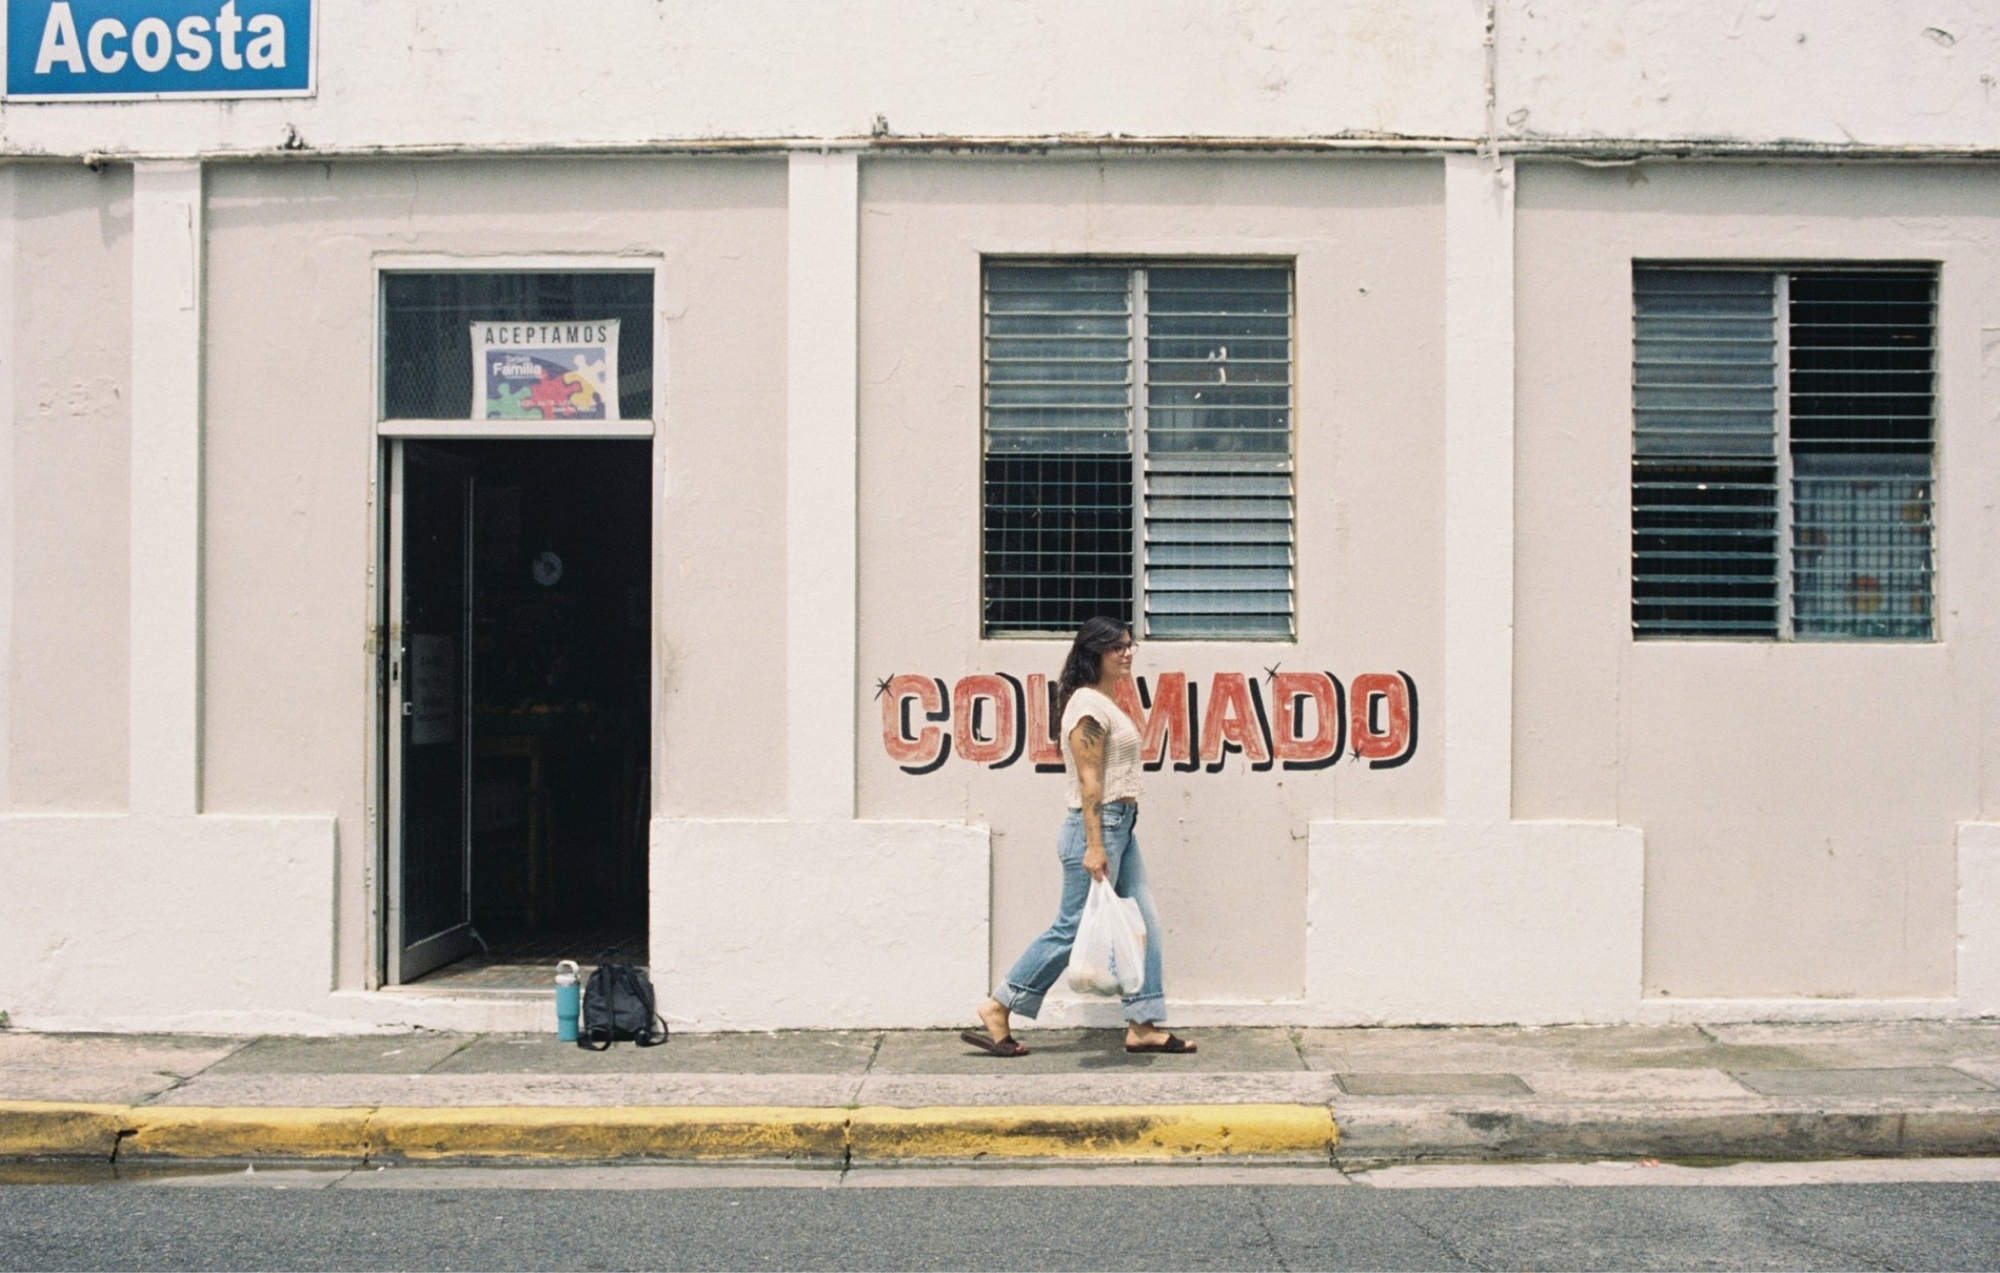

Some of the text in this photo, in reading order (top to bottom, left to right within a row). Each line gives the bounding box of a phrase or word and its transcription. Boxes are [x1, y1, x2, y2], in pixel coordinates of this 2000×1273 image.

[34, 0, 286, 74] Acosta
[485, 325, 607, 344] ACEPTAMOS
[493, 362, 542, 376] Familia
[881, 670, 1417, 775] COLMADO
